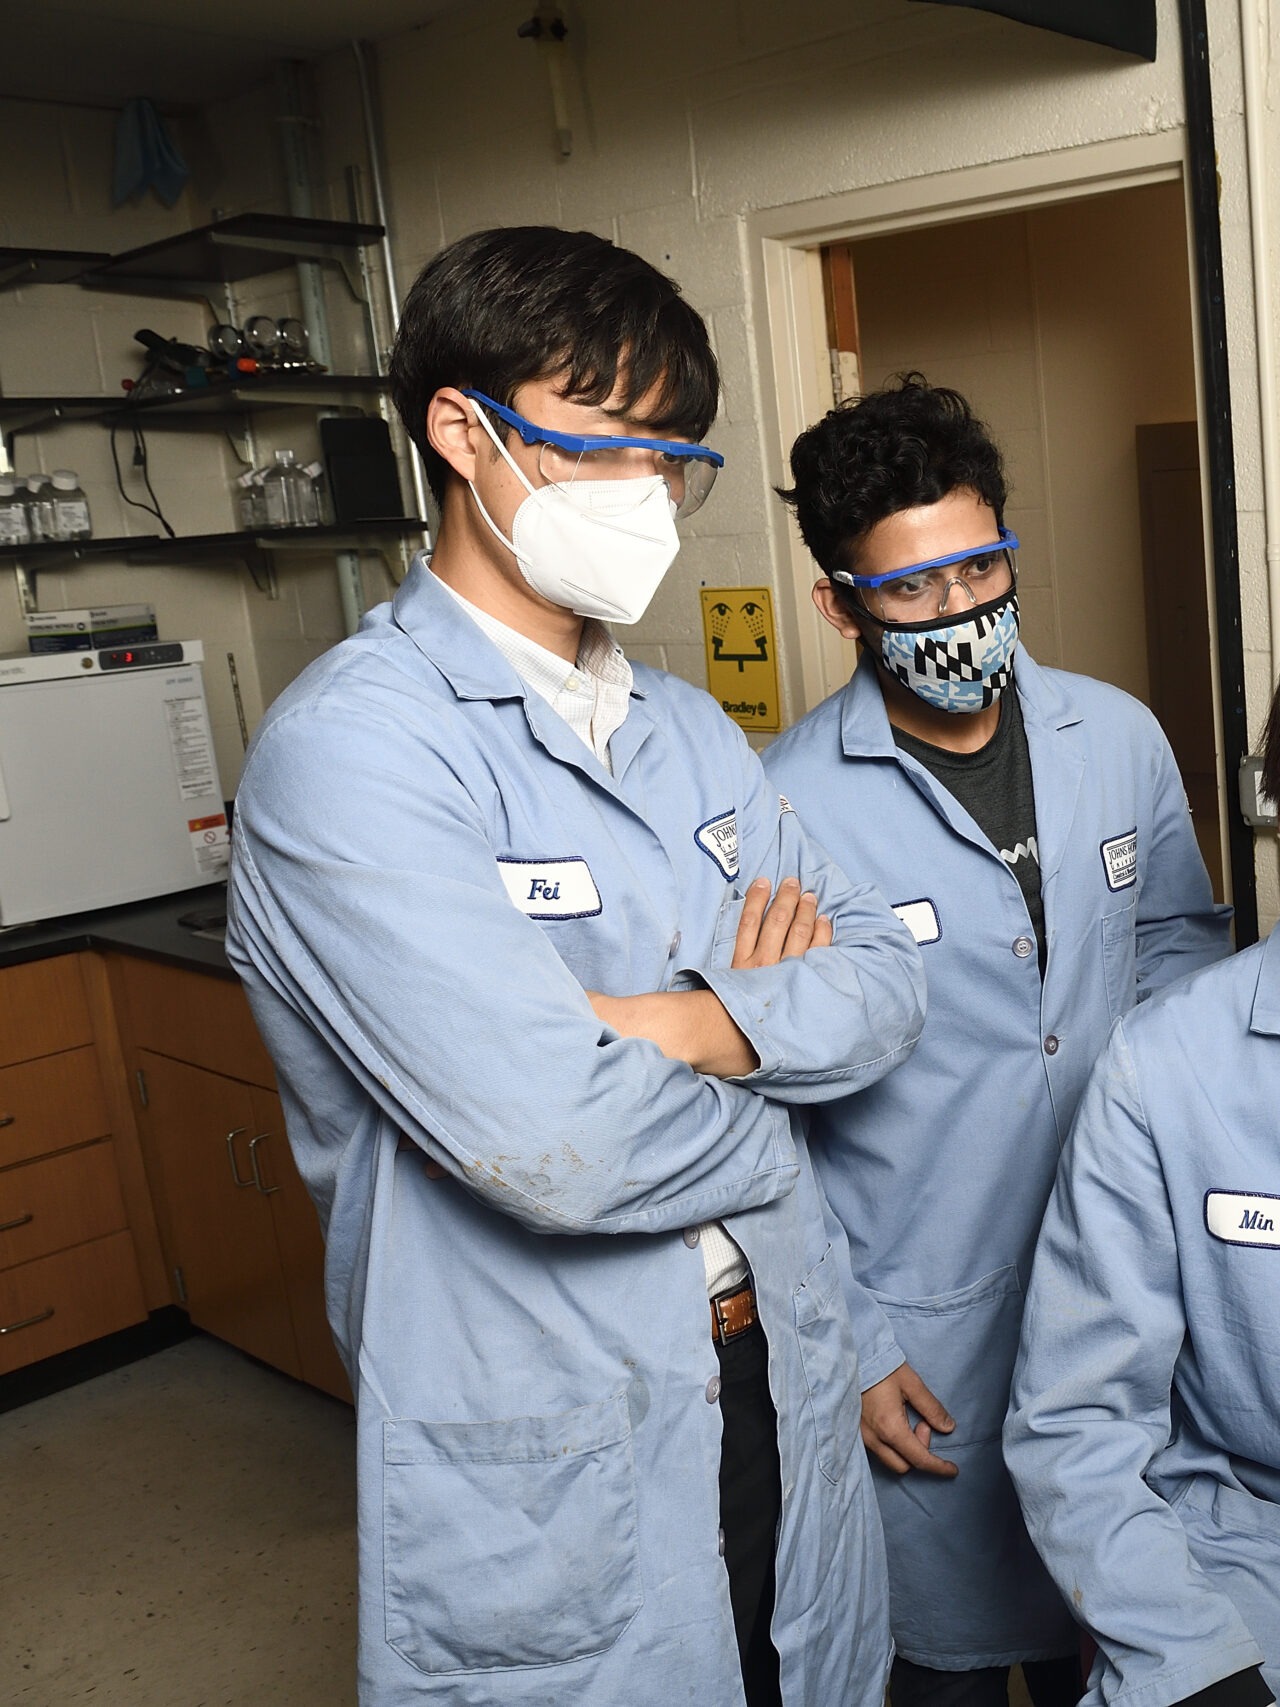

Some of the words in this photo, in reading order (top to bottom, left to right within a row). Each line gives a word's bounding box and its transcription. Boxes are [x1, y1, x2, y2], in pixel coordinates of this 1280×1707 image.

[722, 700, 757, 716] Bradley
[1108, 845, 1128, 865] JOHNS
[526, 878, 561, 901] Fei
[1238, 1209, 1275, 1232] Min
